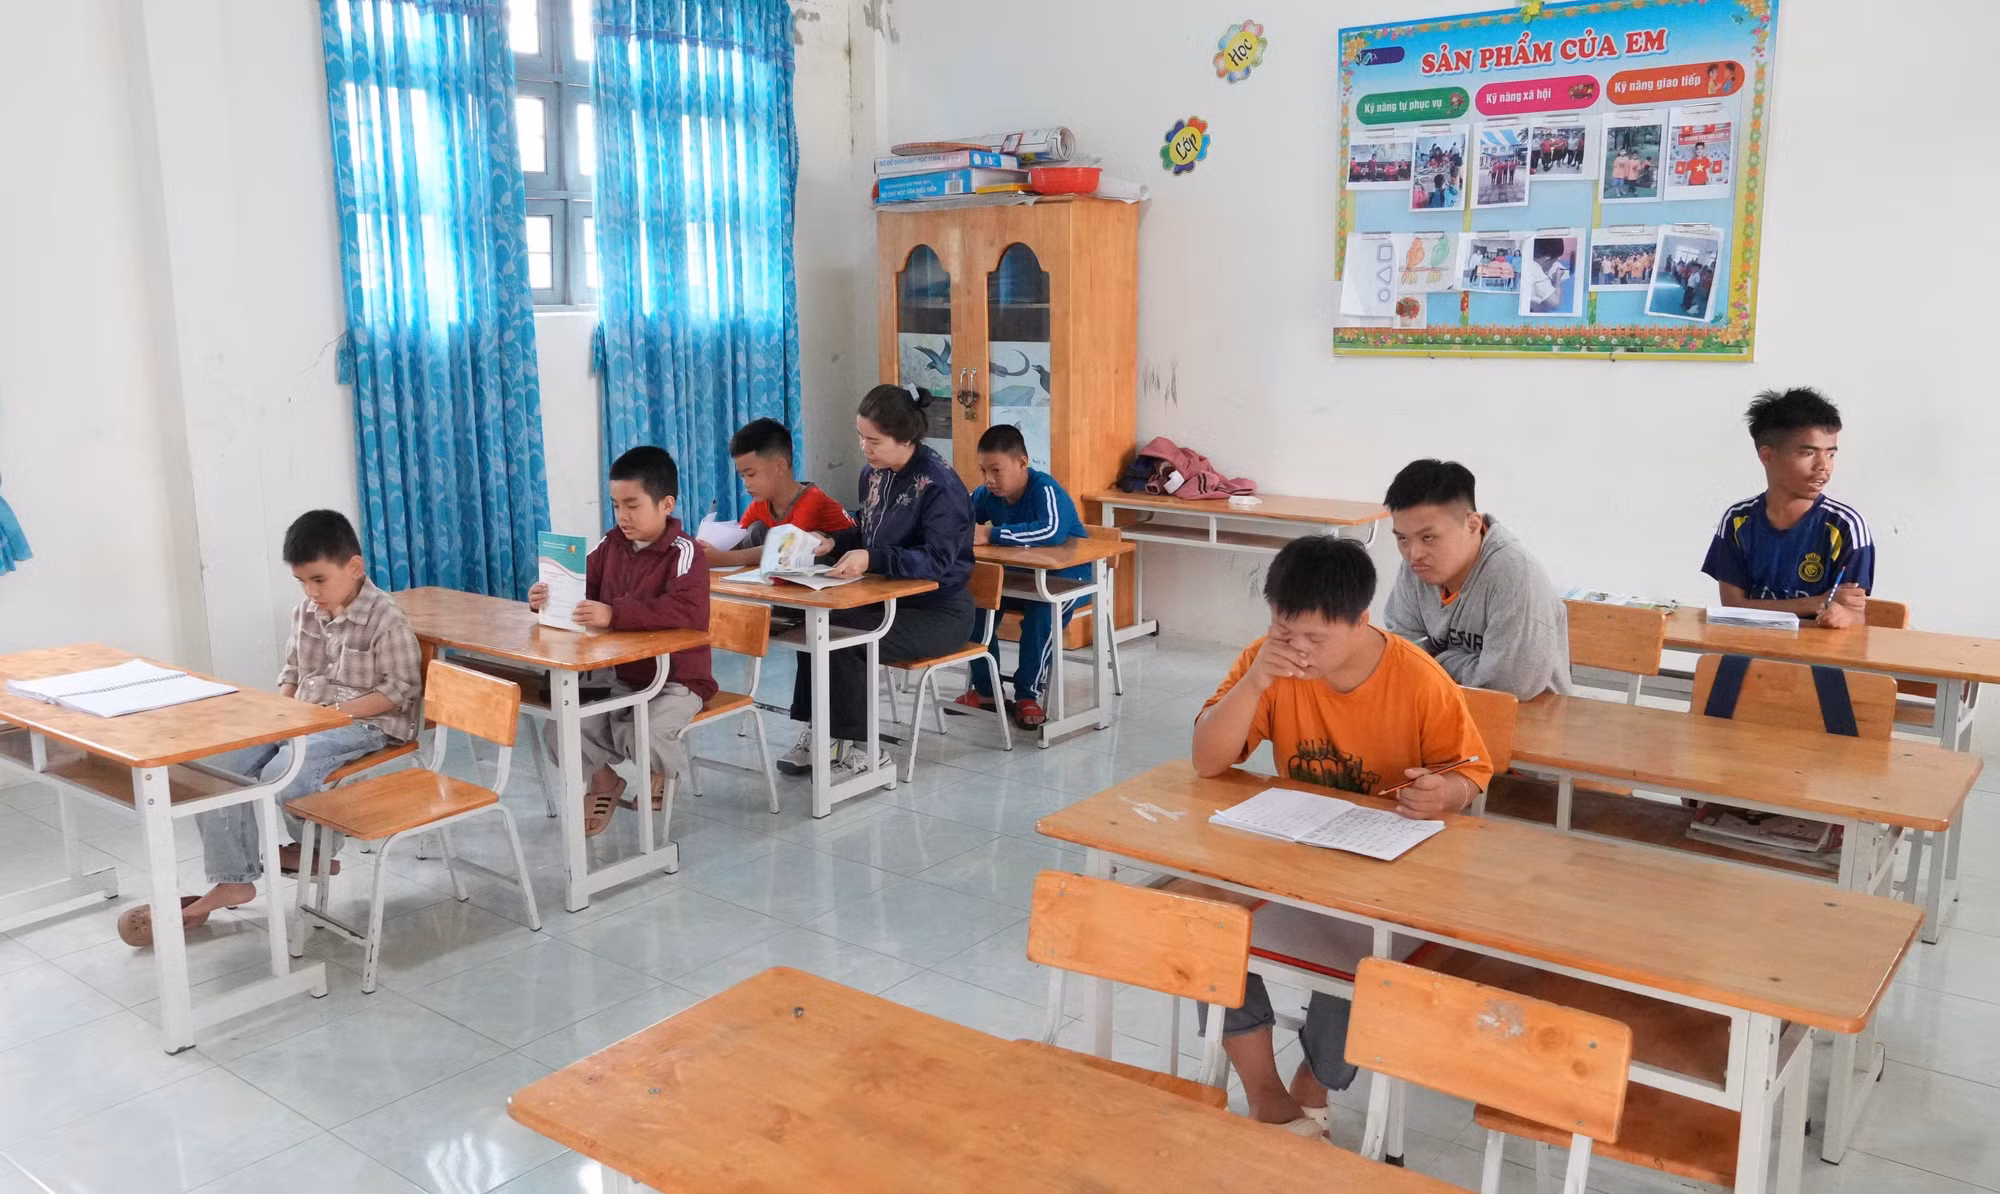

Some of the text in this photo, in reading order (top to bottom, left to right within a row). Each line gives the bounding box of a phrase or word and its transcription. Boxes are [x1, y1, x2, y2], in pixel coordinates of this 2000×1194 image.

[1228, 38, 1253, 67] Học
[1421, 29, 1667, 74] SẢN PHẨM CỦA EM
[1614, 73, 1701, 93] Kỹ năng giao tiếp
[1364, 103, 1375, 114] Kỹ
[1399, 101, 1407, 112] tự
[1409, 99, 1430, 111] phục
[1432, 99, 1443, 110] vụ
[1486, 88, 1552, 104] Kỹ năng xã hội
[1175, 133, 1199, 160] Lớp
